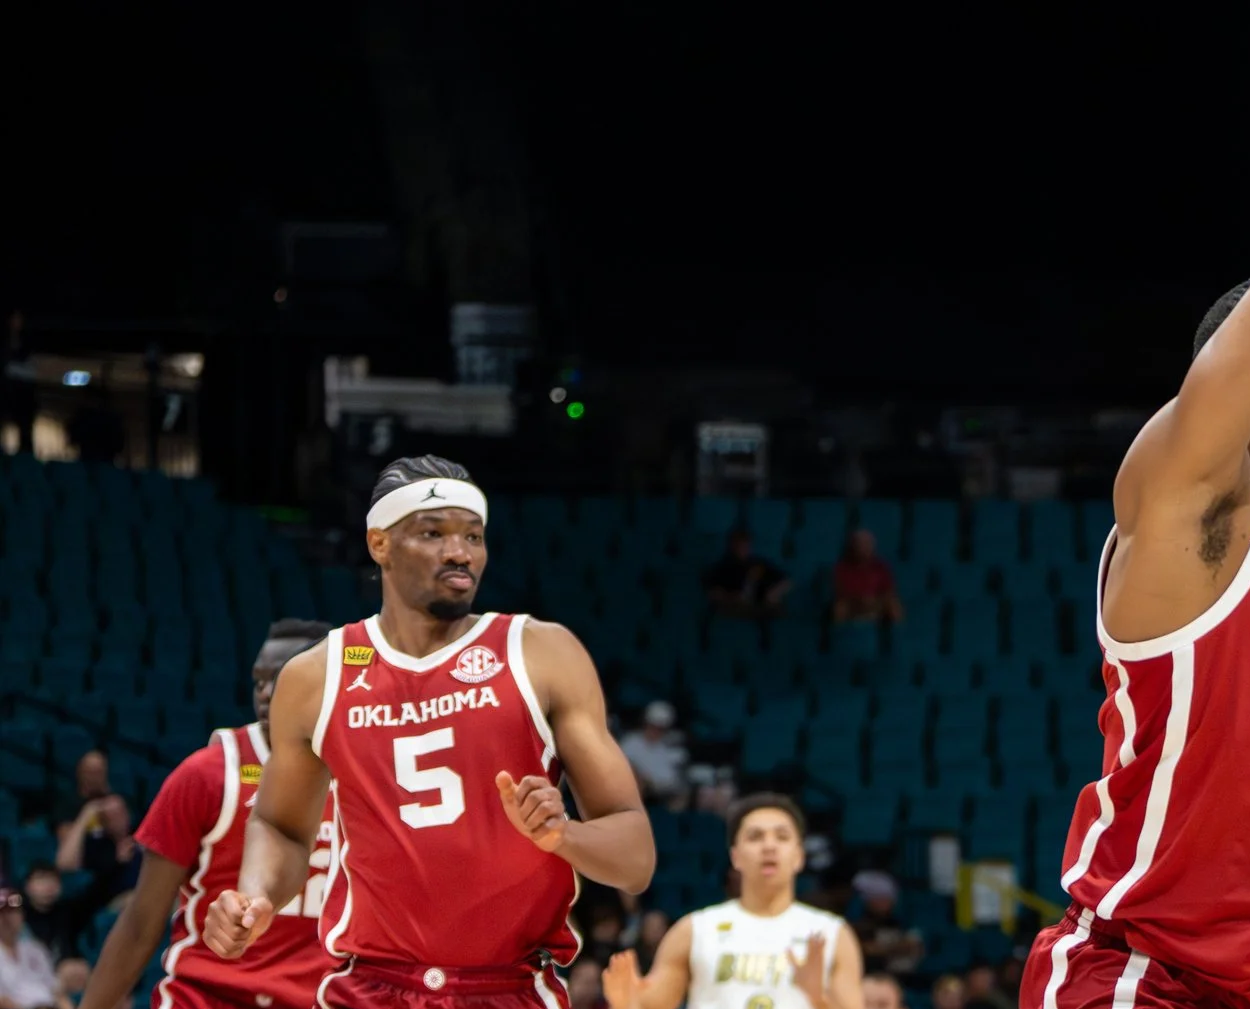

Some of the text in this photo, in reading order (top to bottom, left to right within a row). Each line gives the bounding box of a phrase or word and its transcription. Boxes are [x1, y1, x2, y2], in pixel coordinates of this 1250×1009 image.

[458, 648, 496, 674] SEC
[348, 686, 500, 728] OKLAHOMA
[393, 726, 465, 829] 5
